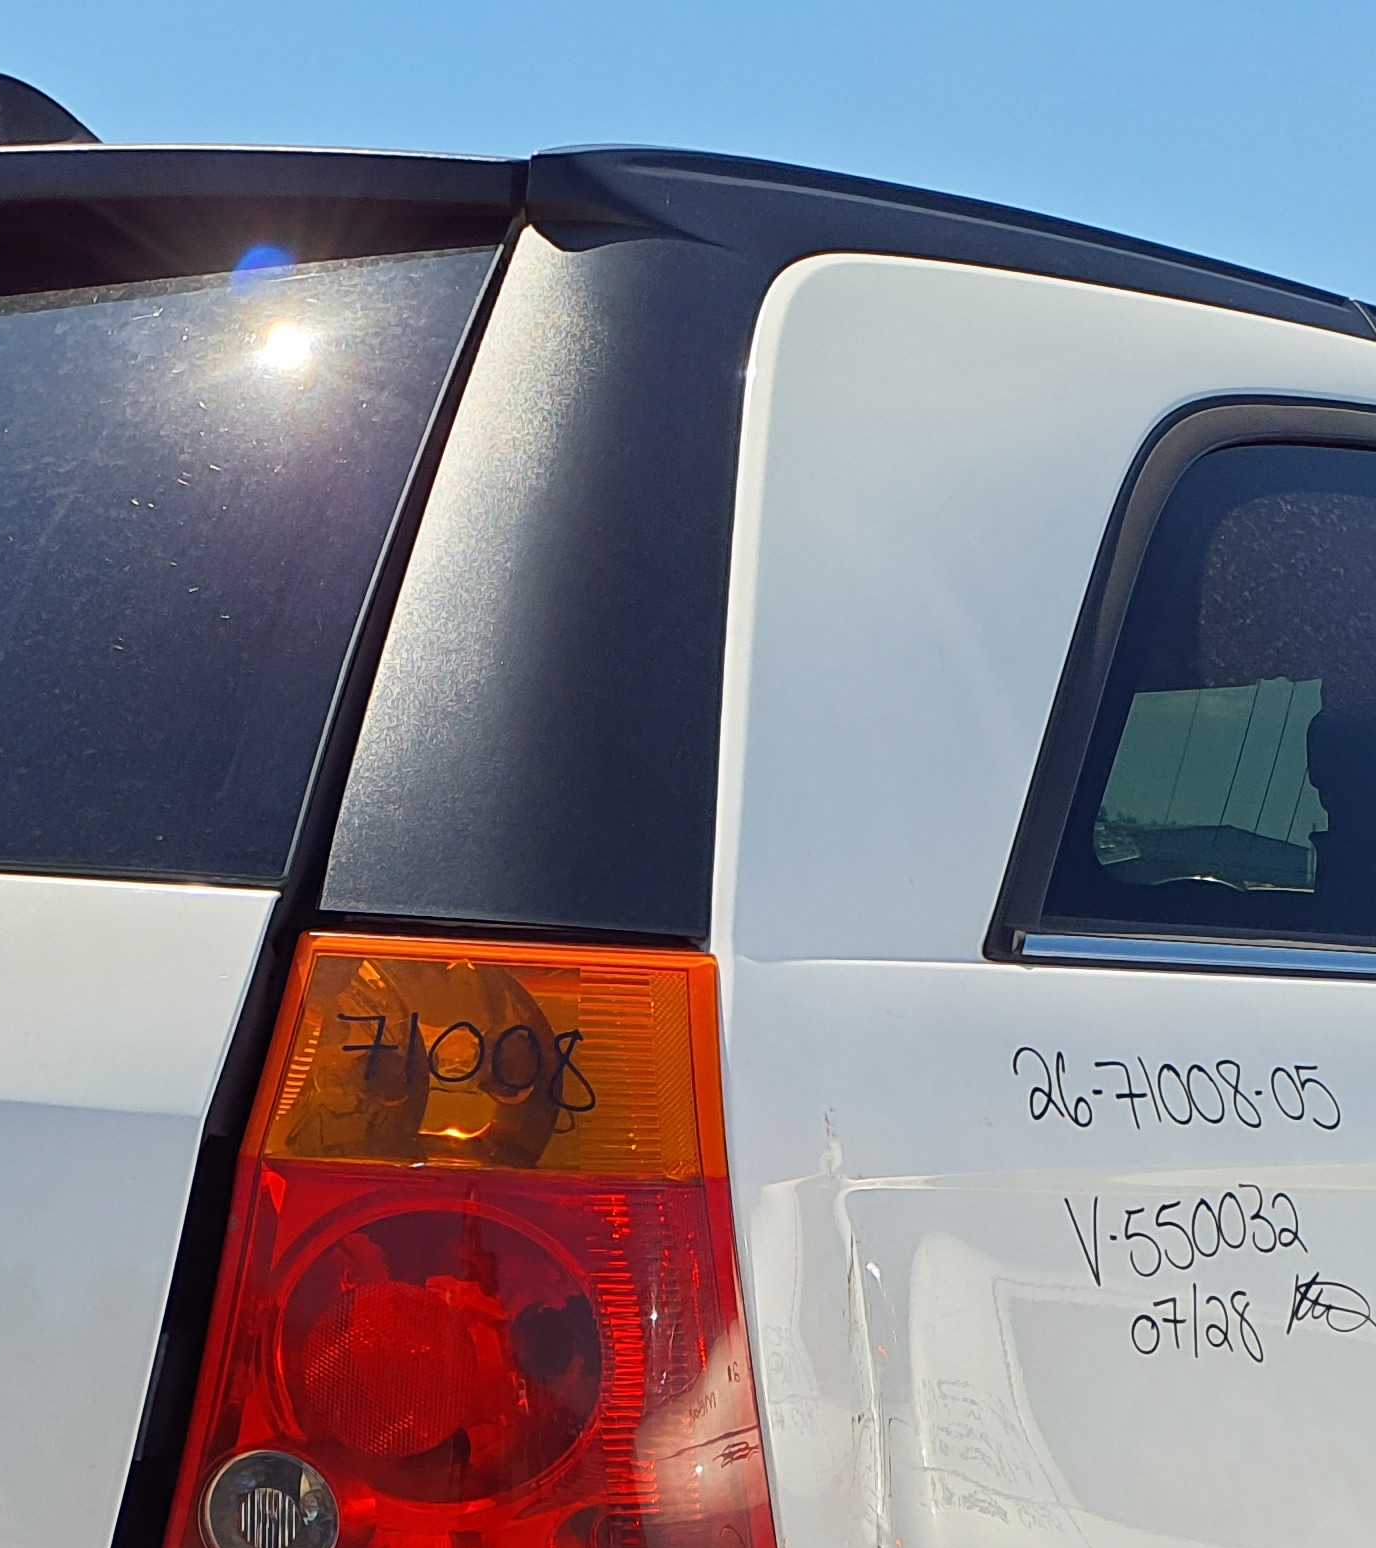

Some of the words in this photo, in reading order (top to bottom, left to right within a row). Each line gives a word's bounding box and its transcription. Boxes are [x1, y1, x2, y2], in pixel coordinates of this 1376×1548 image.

[336, 1011, 597, 1112] 71008
[1012, 1046, 1341, 1130] 26-71008-05
[1063, 1183, 1308, 1287] V-550032
